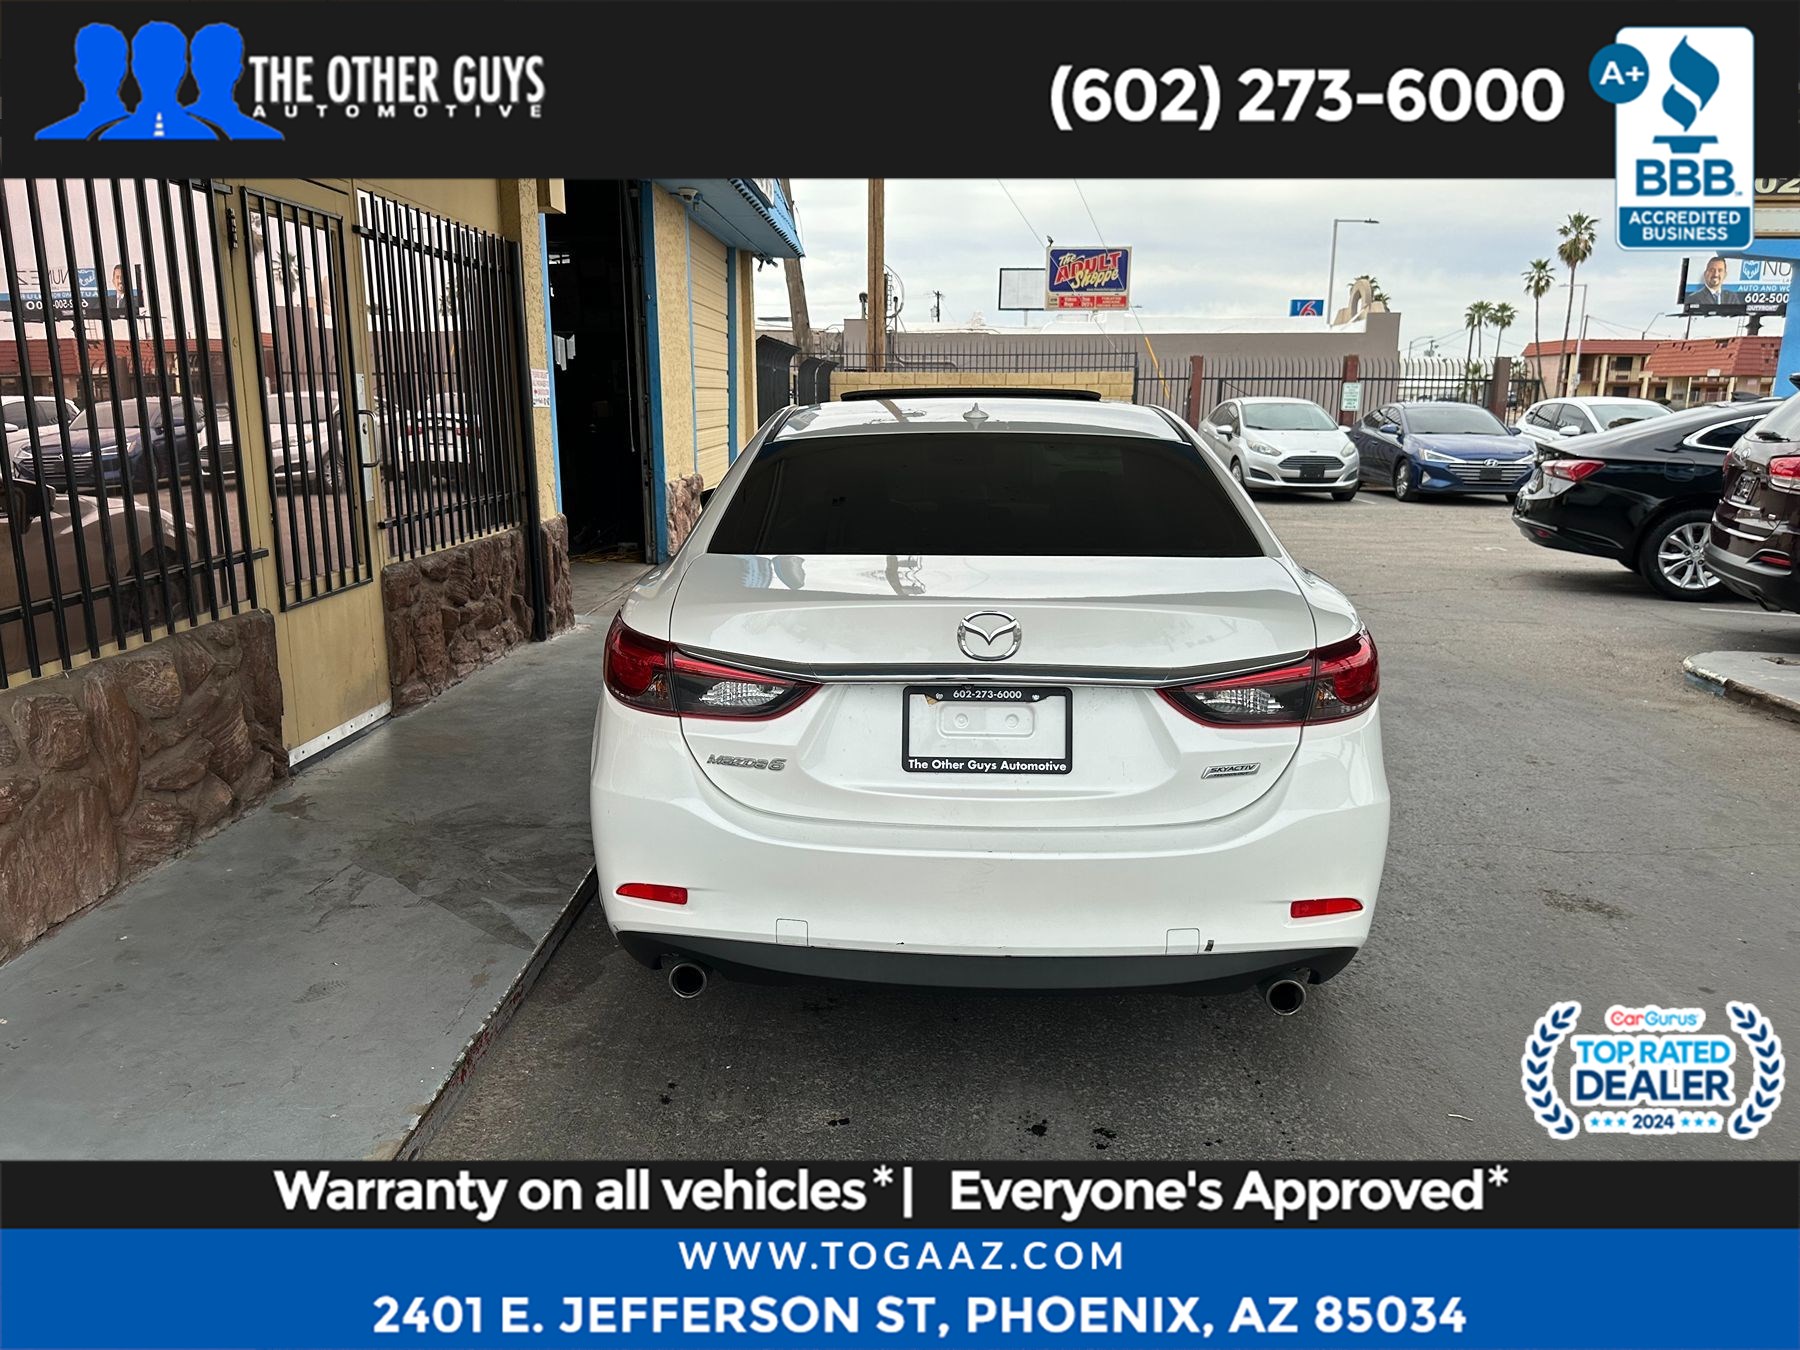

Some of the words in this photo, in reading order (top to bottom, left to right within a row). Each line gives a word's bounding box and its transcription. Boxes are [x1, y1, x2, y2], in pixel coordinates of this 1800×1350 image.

[1054, 251, 1122, 285] ADULT
[1071, 269, 1119, 289] Shoppe
[953, 690, 1022, 700] 602-273-6000
[908, 758, 929, 770] The
[931, 759, 965, 771] Other
[967, 759, 998, 773] Guys
[1000, 760, 1067, 772] Automotive
[1210, 764, 1256, 773] SKYACTIV
